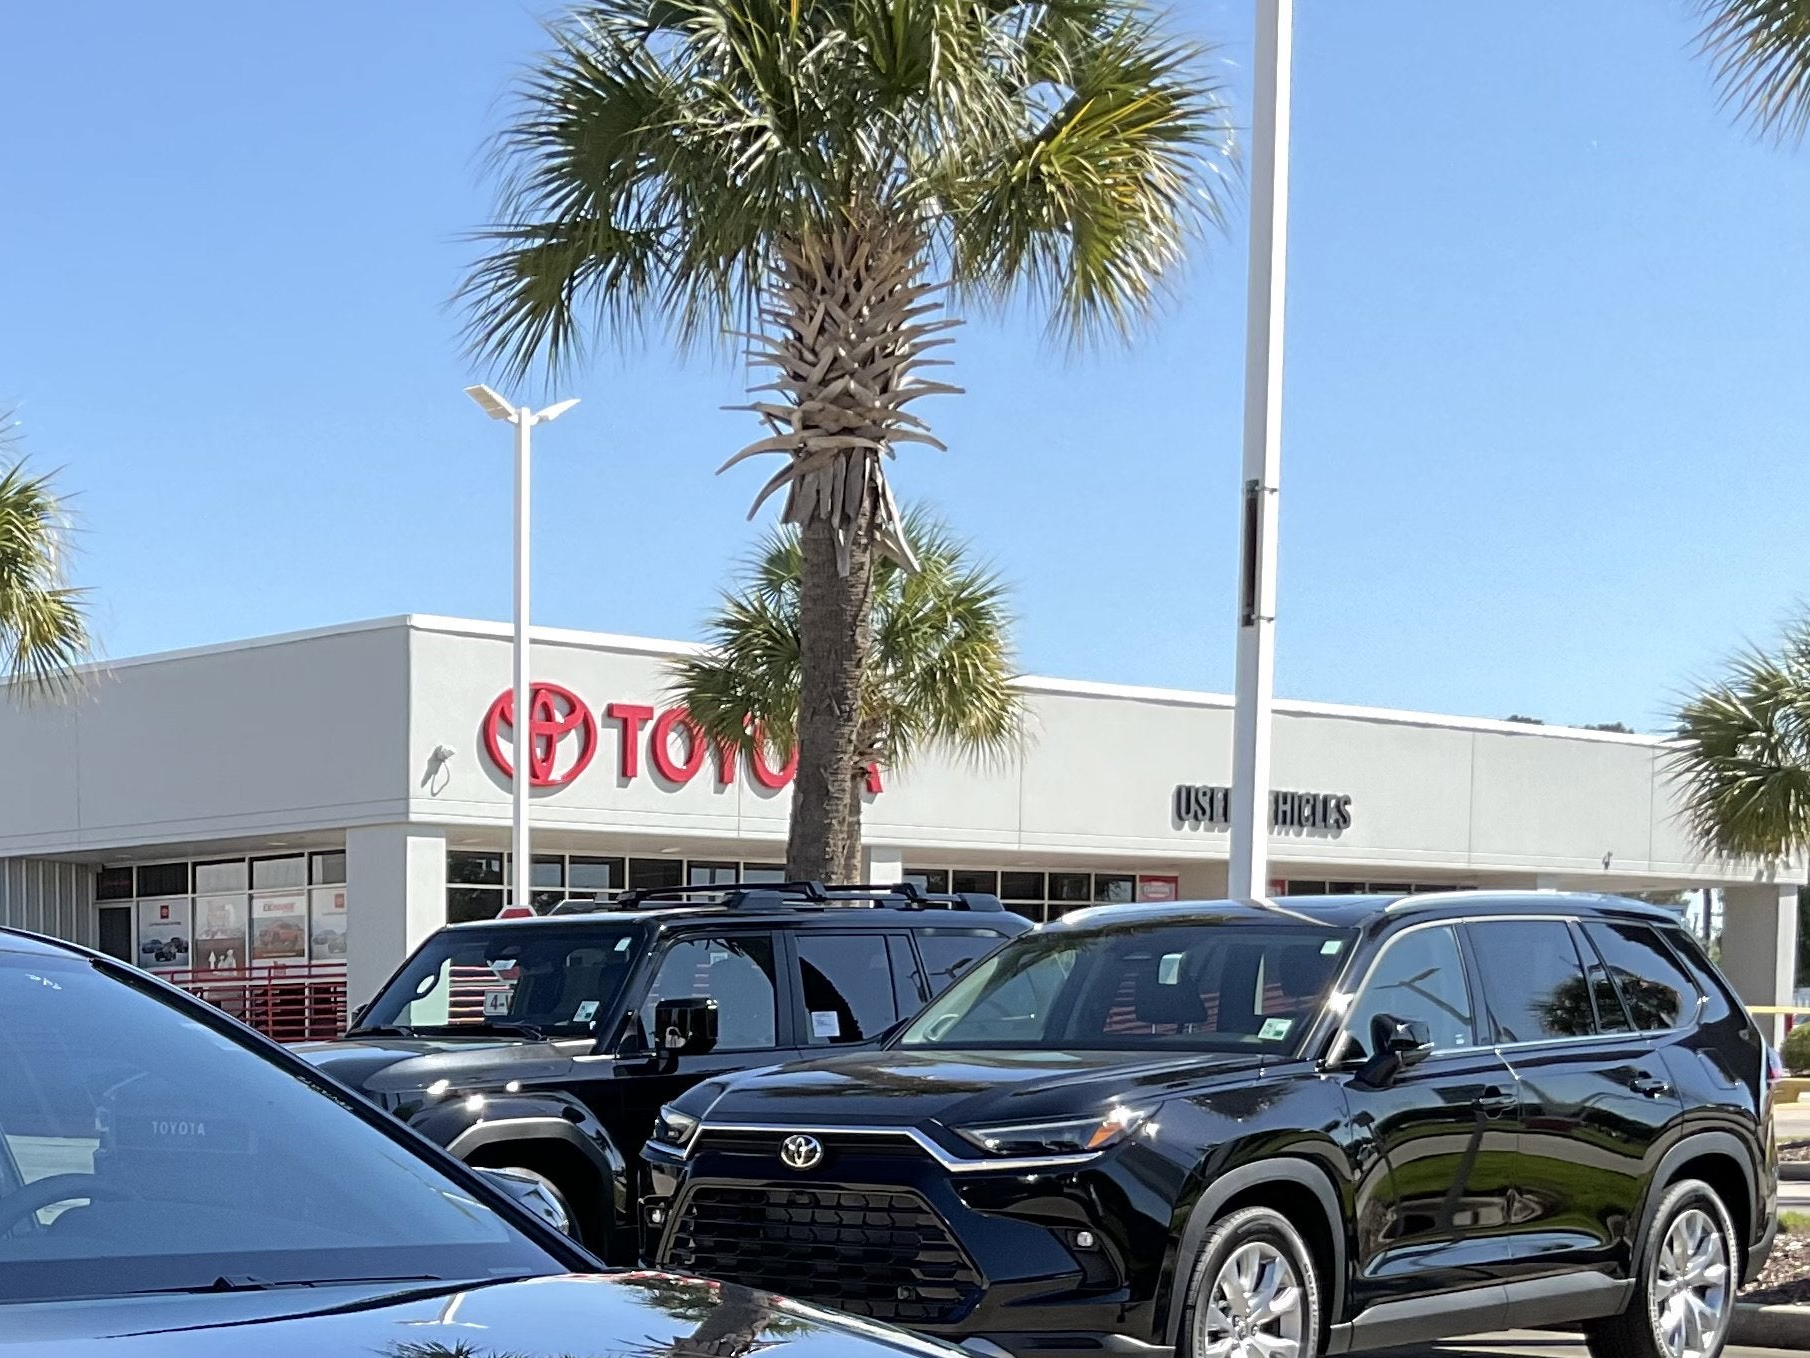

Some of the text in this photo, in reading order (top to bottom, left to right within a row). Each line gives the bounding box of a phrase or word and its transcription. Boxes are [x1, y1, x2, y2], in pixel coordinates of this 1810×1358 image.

[607, 702, 883, 795] TOYO
[1268, 789, 1352, 831] EHICLES
[151, 1121, 206, 1136] TOYOTA
